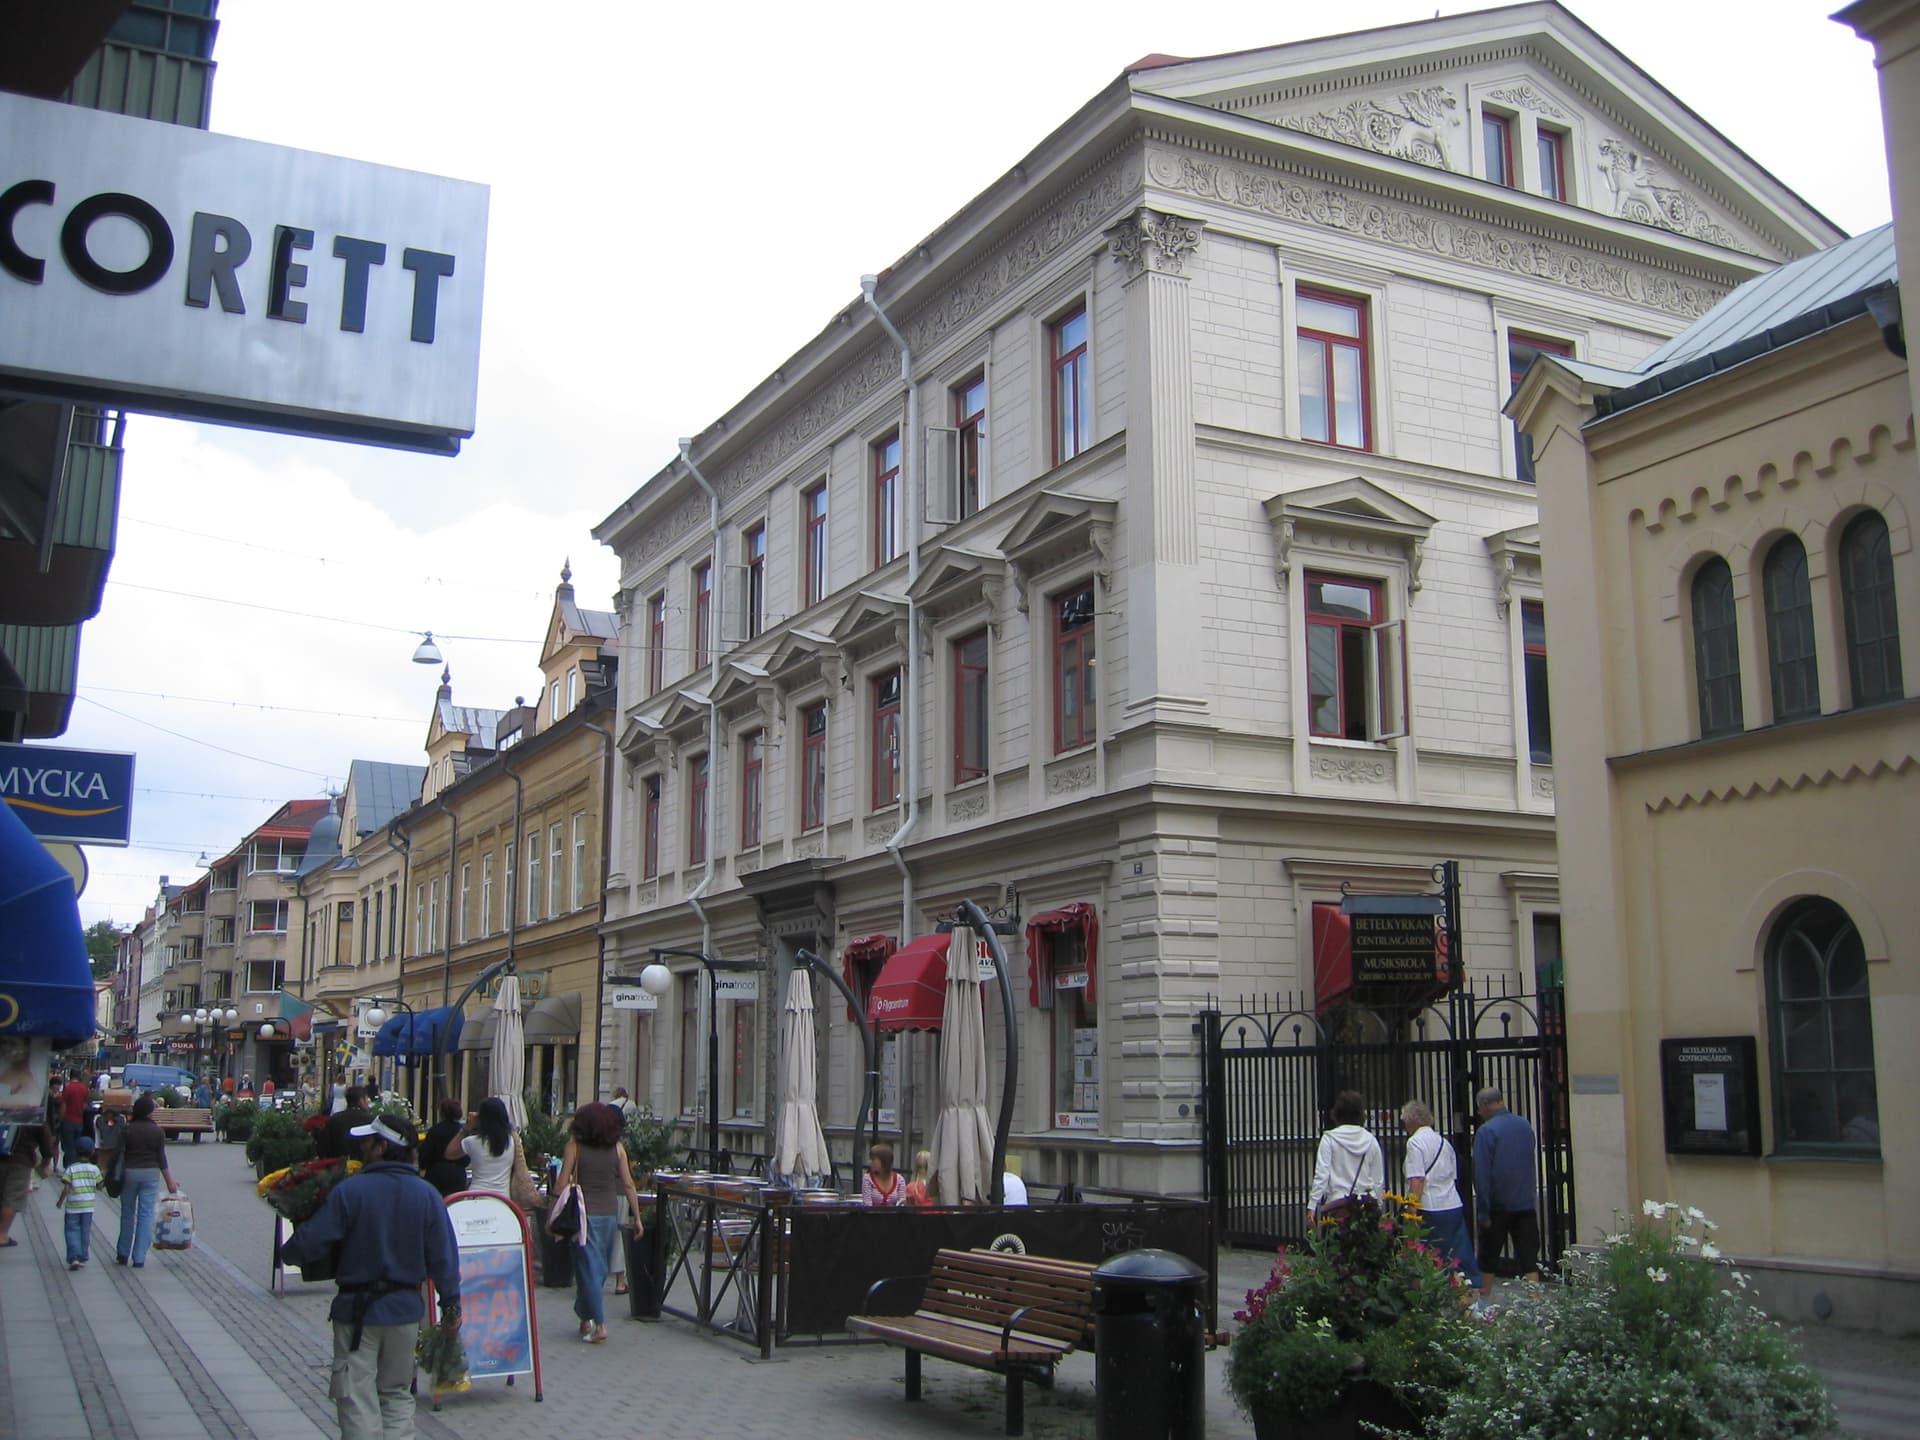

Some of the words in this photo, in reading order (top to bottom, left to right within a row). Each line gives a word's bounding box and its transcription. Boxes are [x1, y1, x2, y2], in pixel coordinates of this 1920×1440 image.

[0, 179, 456, 344] CORETT
[1355, 918, 1432, 930] BETELKYRKAN
[1356, 933, 1432, 945] CENTRUMGÅRDEN
[1364, 957, 1427, 969] MUSIKSKOLA
